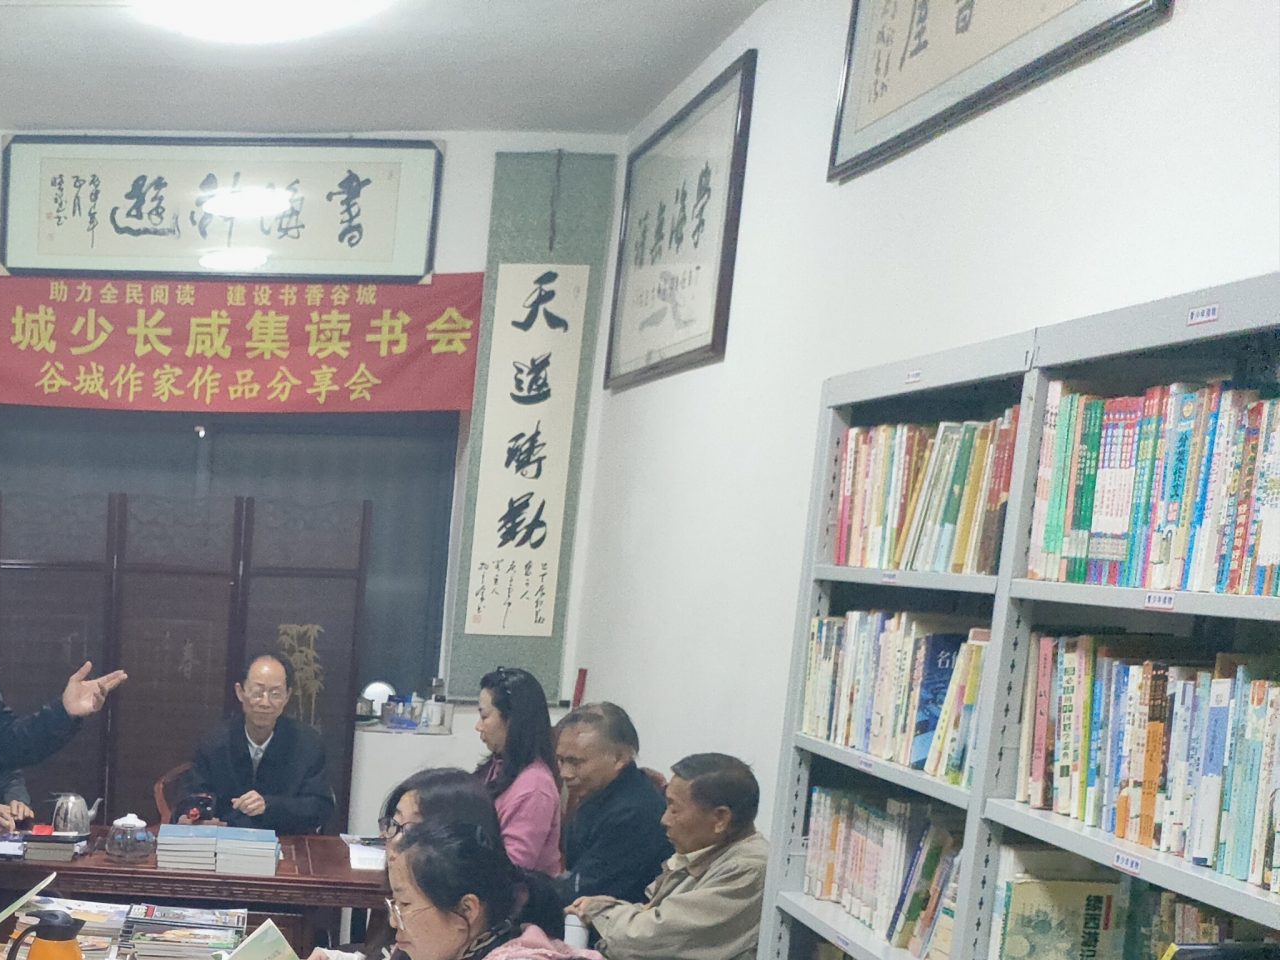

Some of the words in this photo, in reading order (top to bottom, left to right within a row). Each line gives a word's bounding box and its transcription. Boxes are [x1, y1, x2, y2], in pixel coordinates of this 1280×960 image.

[49, 281, 195, 305] 助力全民阅读
[226, 284, 377, 306] 建设书香谷城
[35, 360, 382, 403] 谷城作家作品分享会
